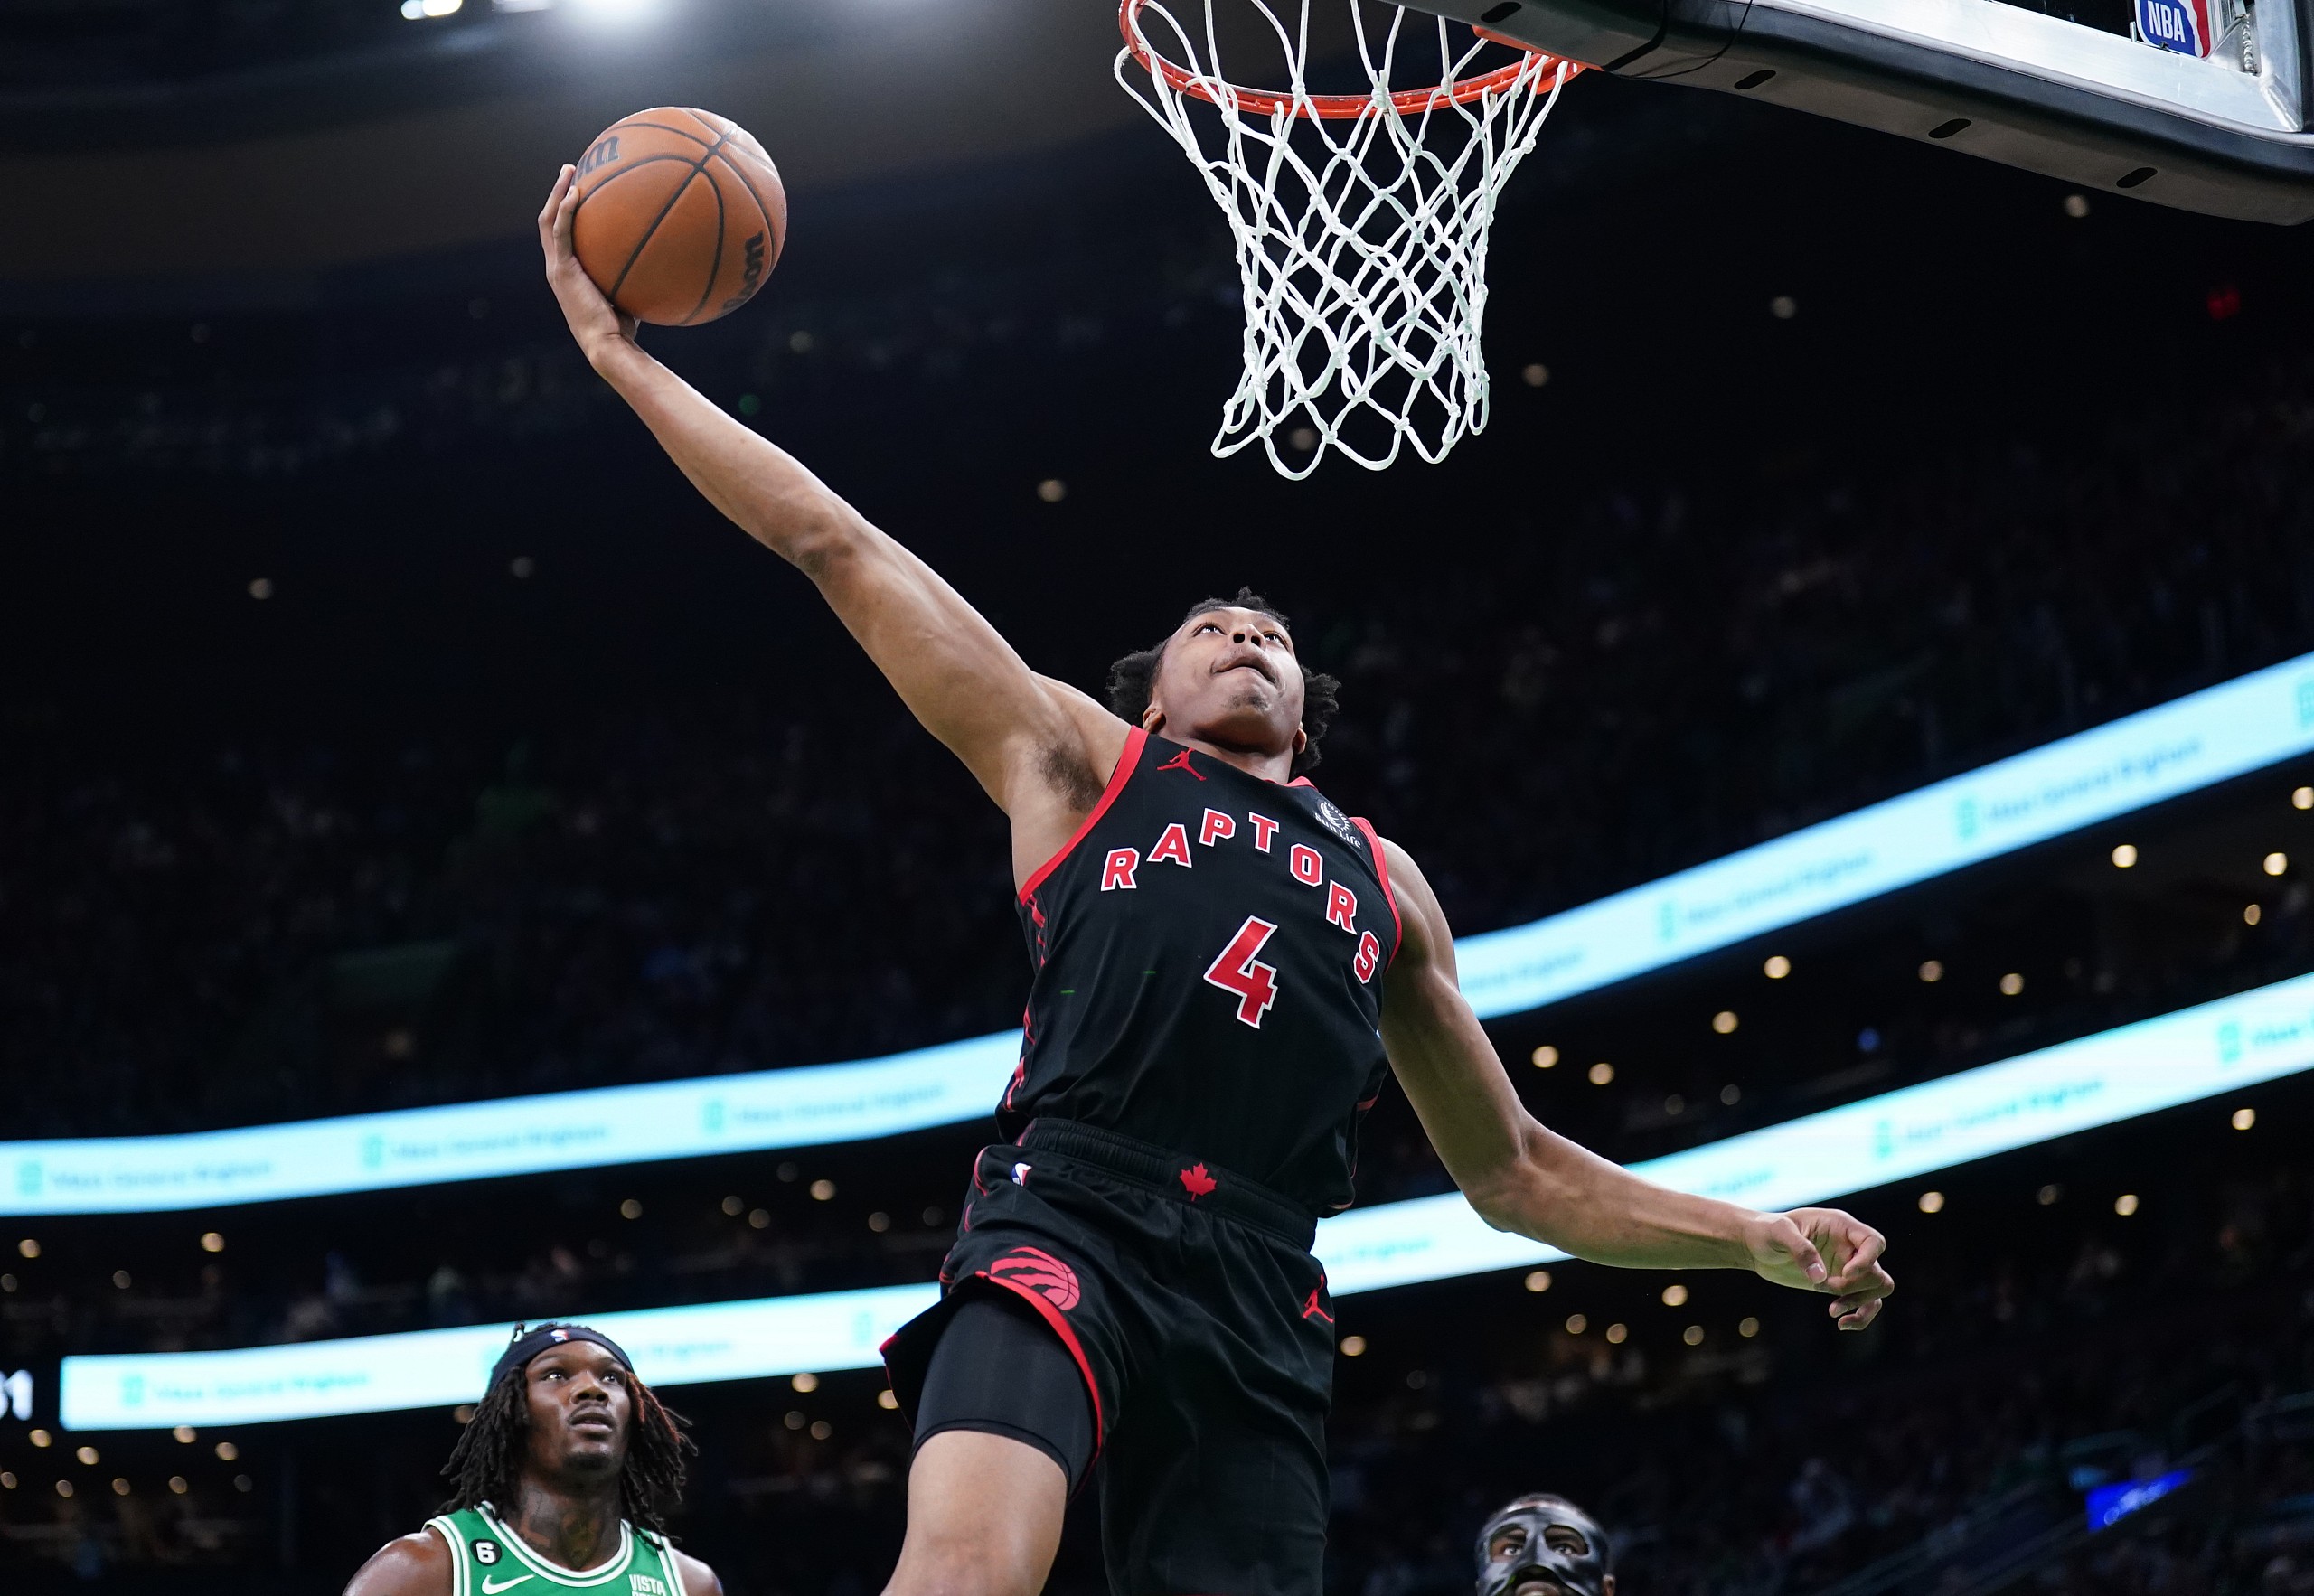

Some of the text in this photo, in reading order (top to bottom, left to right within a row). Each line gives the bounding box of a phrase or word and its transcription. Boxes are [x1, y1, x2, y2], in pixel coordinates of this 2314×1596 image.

[2147, 0, 2186, 43] NBA
[1339, 829, 1361, 849] Life
[1101, 808, 1380, 984] RAPTORS
[1203, 915, 1279, 1029] 4
[475, 1541, 496, 1563] 6
[628, 1573, 667, 1596] VISTA
